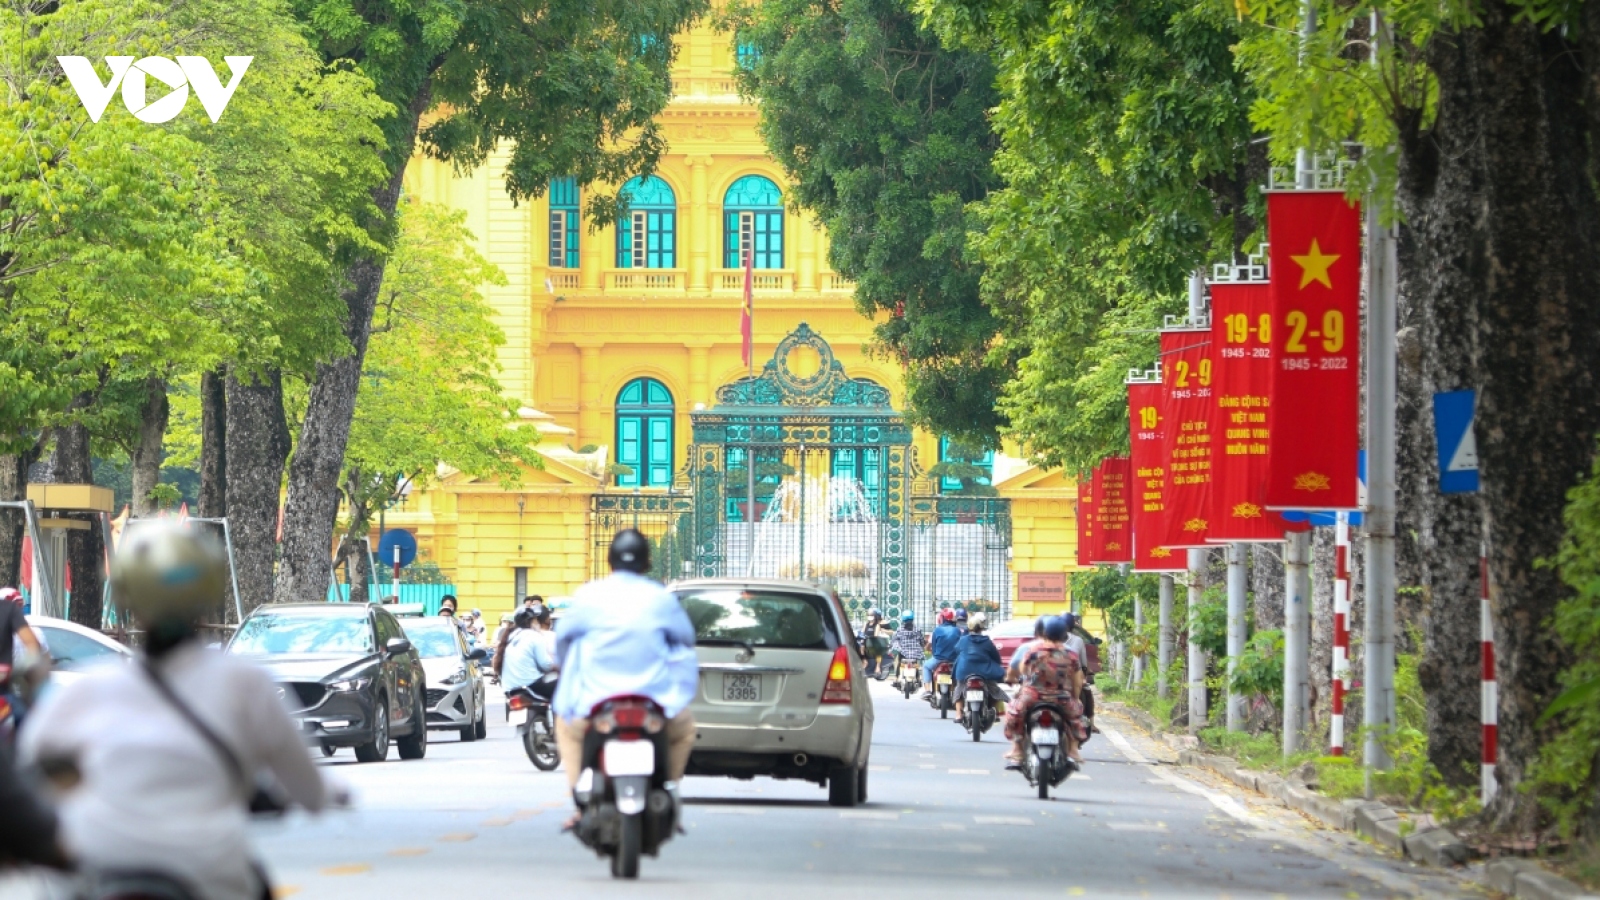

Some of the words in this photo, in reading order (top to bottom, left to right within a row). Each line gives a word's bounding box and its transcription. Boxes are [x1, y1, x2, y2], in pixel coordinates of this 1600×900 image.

[1224, 313, 1271, 344] 19-8
[1285, 310, 1344, 353] 2-9
[1221, 348, 1245, 357] 1945
[1252, 348, 1270, 358] 202
[1282, 359, 1310, 370] 1945
[1320, 357, 1348, 370] 2022
[1176, 359, 1211, 387] 2-9
[1172, 390, 1190, 398] 1945
[1139, 406, 1164, 429] 19-
[1231, 410, 1248, 425] VIỆT
[1249, 413, 1266, 422] NAM
[1227, 429, 1251, 439] QUANG
[1252, 429, 1270, 438] VINH
[727, 687, 757, 700] 3385
